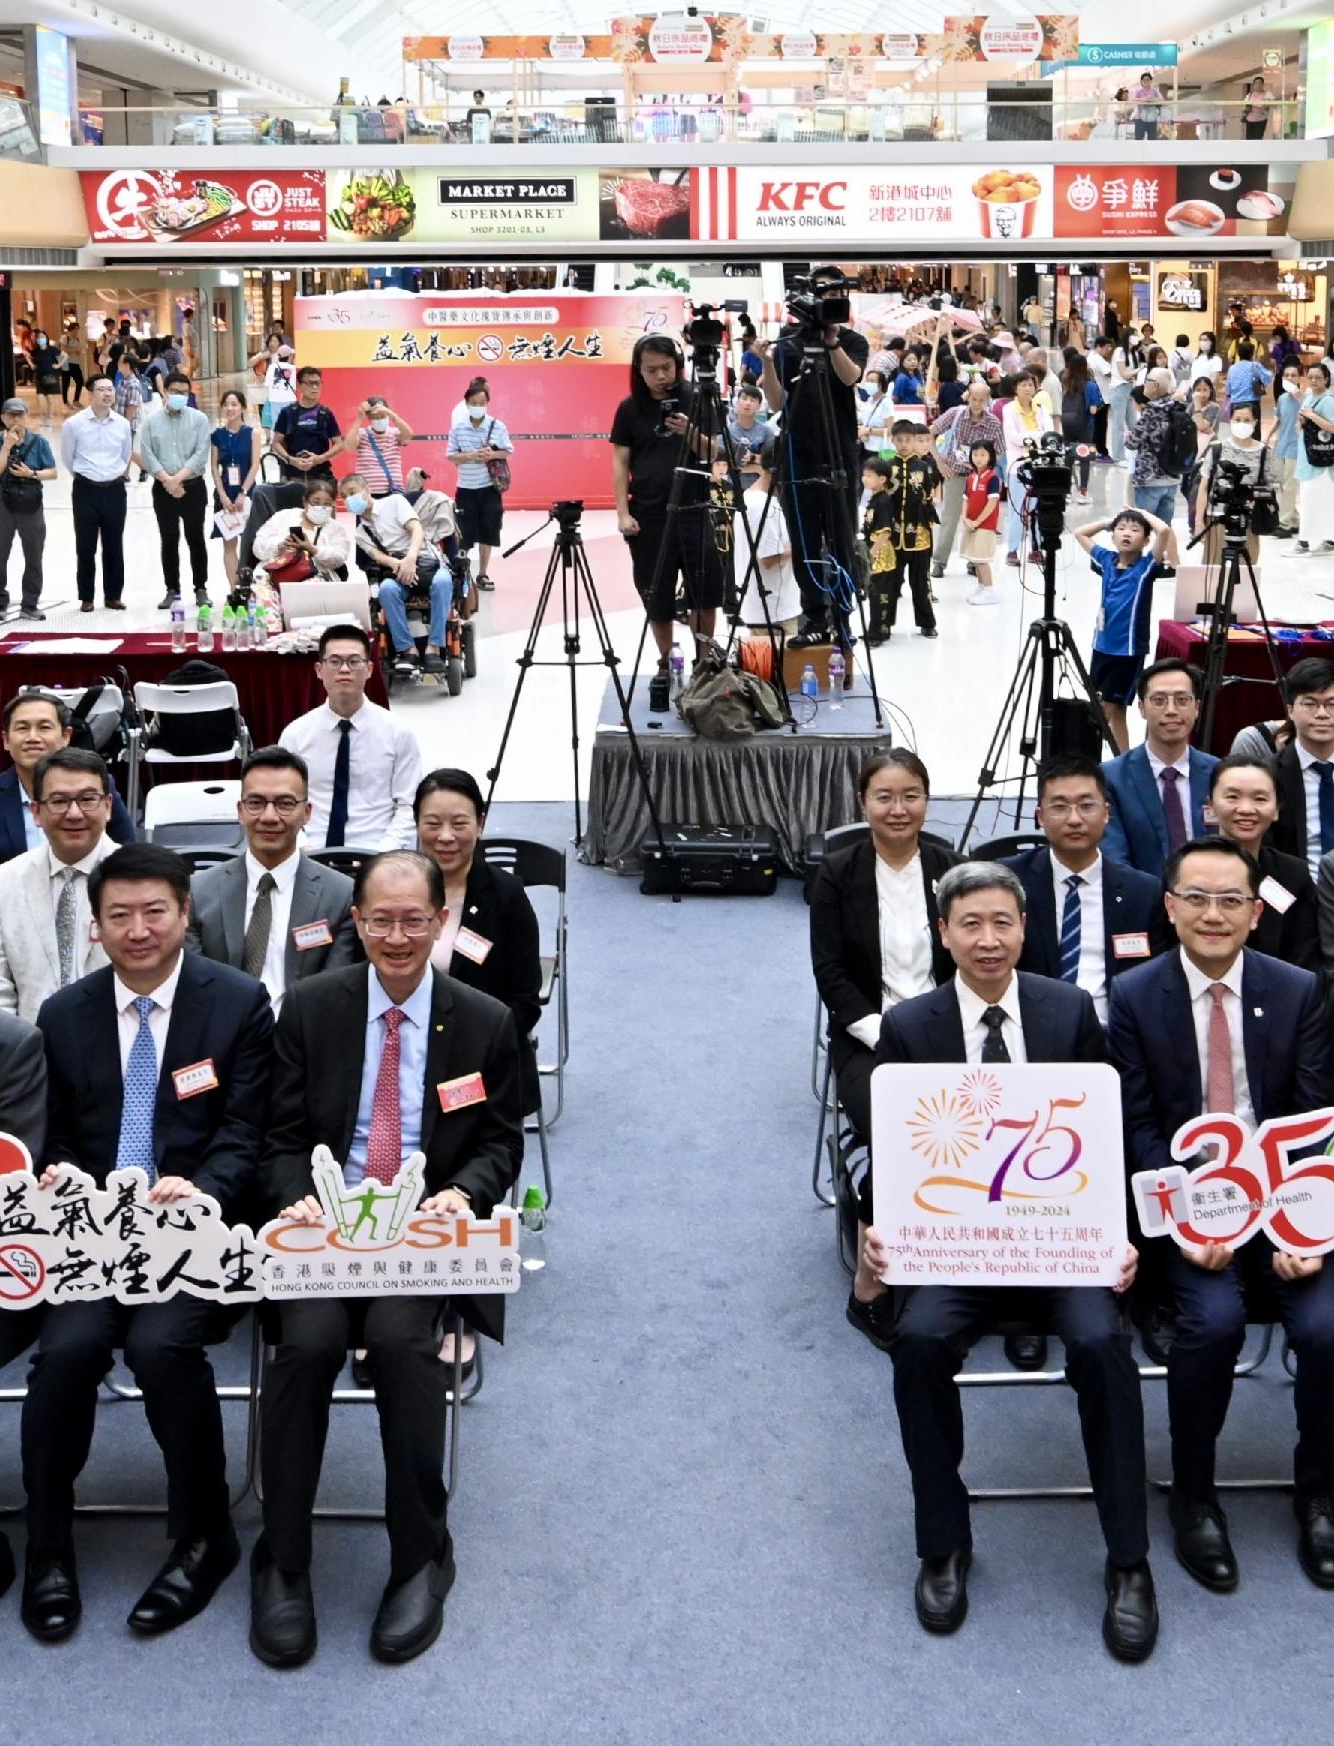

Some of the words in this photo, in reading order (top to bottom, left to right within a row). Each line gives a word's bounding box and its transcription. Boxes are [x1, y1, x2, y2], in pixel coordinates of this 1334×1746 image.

[284, 187, 312, 197] JUST
[448, 184, 515, 197] MARKET
[518, 184, 567, 197] PLACE
[756, 181, 848, 212] KFC
[869, 184, 953, 201] 新港城中心
[1101, 178, 1160, 211] 爭鮮
[284, 198, 321, 208] STEAK
[450, 208, 566, 220] SUPERMARKET
[756, 215, 797, 228] ALWAYS
[798, 215, 847, 227] ORIGINAL
[1125, 211, 1158, 219] EXPRESS
[470, 226, 494, 234] SHOP
[371, 332, 473, 363] 益氣養心
[509, 330, 604, 361] 無煙人生
[984, 1091, 1087, 1203] 75
[1191, 1185, 1238, 1207] 衛生署
[1004, 1205, 1071, 1217] 1949-2024
[1193, 1198, 1262, 1221] Department
[1262, 1199, 1274, 1209] of
[1275, 1191, 1313, 1206] Health
[265, 1218, 513, 1253] COSH
[899, 1225, 1105, 1242] 中華人民共和國成立七十五周年
[992, 1246, 1008, 1258] of
[1009, 1246, 1028, 1258] the
[1030, 1246, 1096, 1261] Founding
[1100, 1246, 1115, 1258] of
[47, 1236, 258, 1296] 無煙人生
[271, 1257, 514, 1280] 香港吸煙與健康委員會
[903, 1261, 924, 1273] the
[928, 1261, 980, 1276] People's
[985, 1261, 1042, 1276] Republic
[1044, 1261, 1059, 1273] of
[1062, 1261, 1100, 1273] China
[271, 1282, 302, 1292] HONG
[304, 1281, 335, 1291] KONG
[337, 1280, 381, 1291] COUNCIL
[383, 1280, 399, 1289] ON
[401, 1279, 448, 1289] SMOKING
[451, 1278, 473, 1287] AND
[475, 1277, 514, 1287] HEALTH
